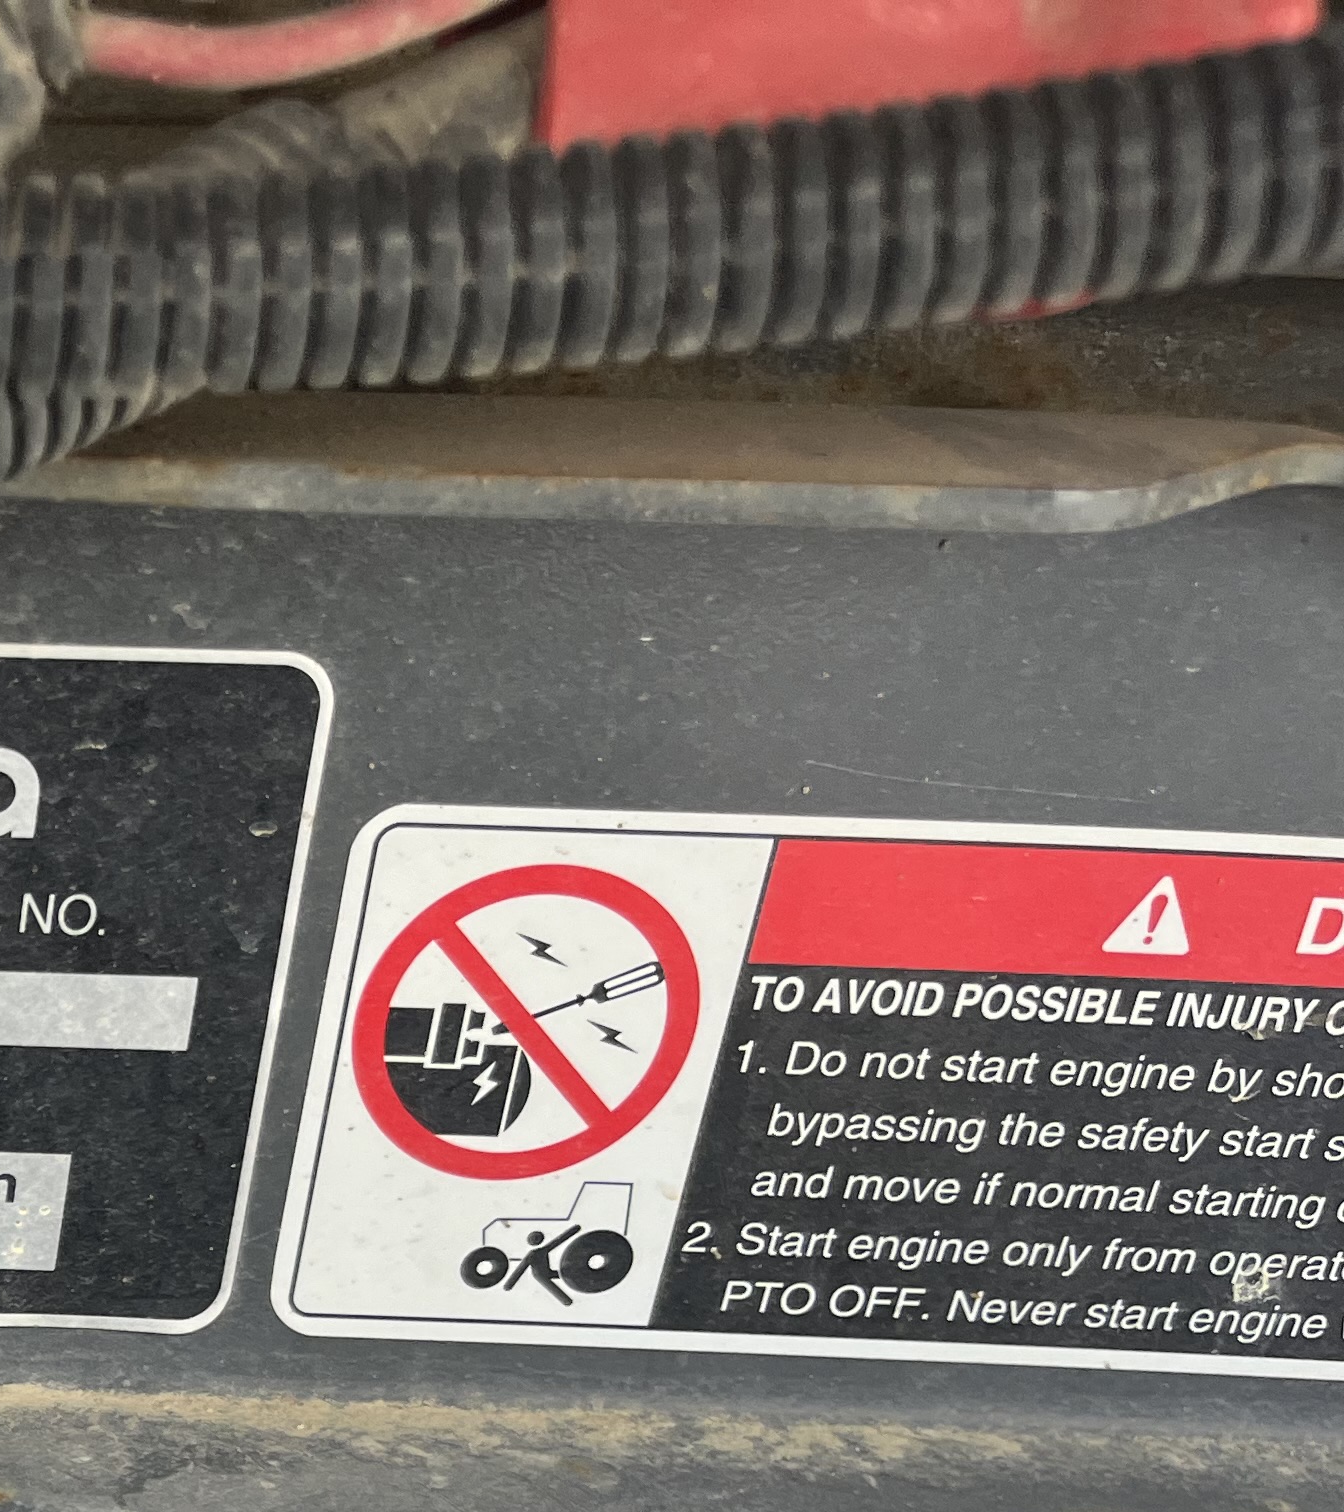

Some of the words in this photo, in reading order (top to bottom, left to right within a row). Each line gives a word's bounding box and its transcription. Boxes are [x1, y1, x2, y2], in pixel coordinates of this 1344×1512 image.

[18, 892, 105, 936] NO.
[751, 975, 805, 1012] TO
[811, 978, 945, 1017] AVOID
[952, 983, 1162, 1026] POSSIBLE
[1166, 992, 1320, 1034] INJURY
[738, 1039, 767, 1074] 1.
[785, 1040, 847, 1077] Do
[859, 1047, 932, 1080] not
[940, 1049, 1040, 1085] start
[1050, 1054, 1196, 1097] engine
[1207, 1058, 1264, 1103] by
[1271, 1062, 1344, 1099] sho
[767, 1102, 987, 1153] bypassing
[998, 1112, 1066, 1148] the
[1077, 1117, 1211, 1162] safety
[1218, 1125, 1316, 1160] start
[750, 1165, 835, 1199] and
[843, 1174, 961, 1204] move
[972, 1172, 1005, 1206] if
[1009, 1179, 1161, 1213] normal
[1168, 1183, 1327, 1230] starting
[681, 1221, 719, 1255] 2.
[735, 1222, 838, 1259] Start
[847, 1230, 990, 1271] engine
[1002, 1235, 1093, 1277] only
[1101, 1237, 1197, 1274] from
[1208, 1250, 1344, 1286] operat
[719, 1280, 817, 1315] PTO
[829, 1284, 929, 1321] OFF.
[946, 1289, 1077, 1326] Never
[1083, 1299, 1180, 1332] start
[1188, 1304, 1328, 1344] engine
